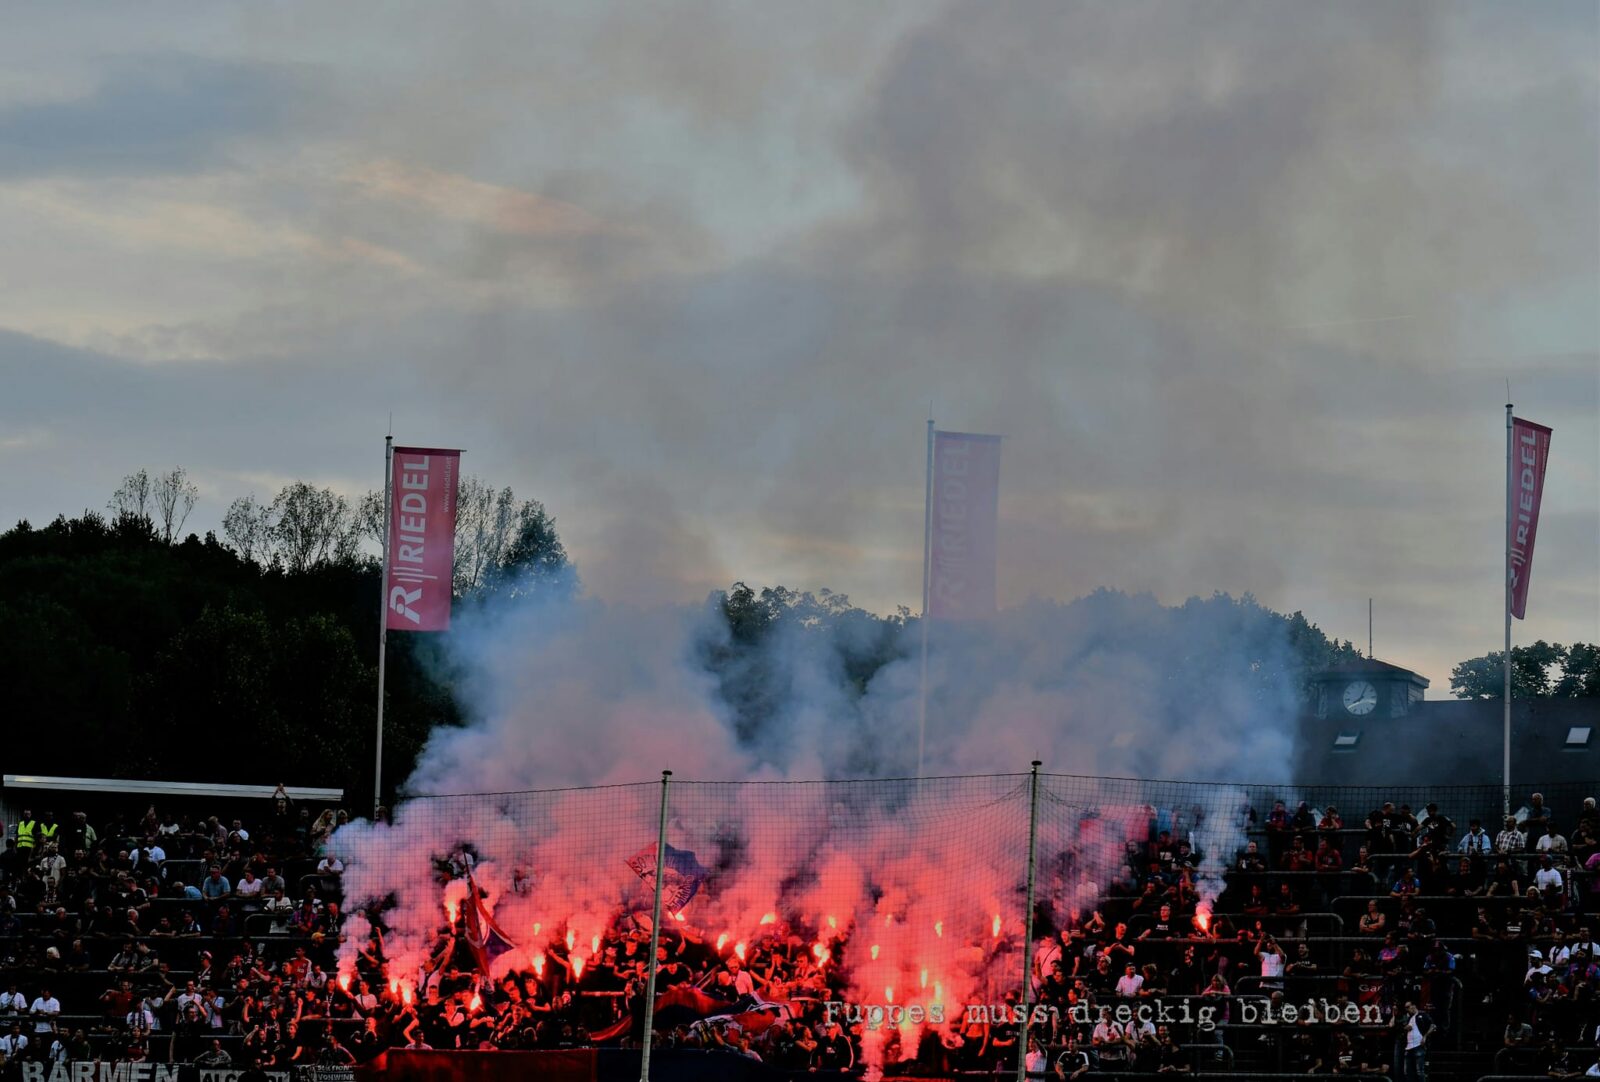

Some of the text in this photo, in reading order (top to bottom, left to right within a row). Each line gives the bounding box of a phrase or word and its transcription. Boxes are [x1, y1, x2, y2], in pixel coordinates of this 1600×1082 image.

[398, 455, 430, 564] RIEDEL
[941, 440, 970, 551] RIEDEL
[1516, 429, 1537, 547] RIEDEL
[22, 1061, 179, 1082] BARMEN
